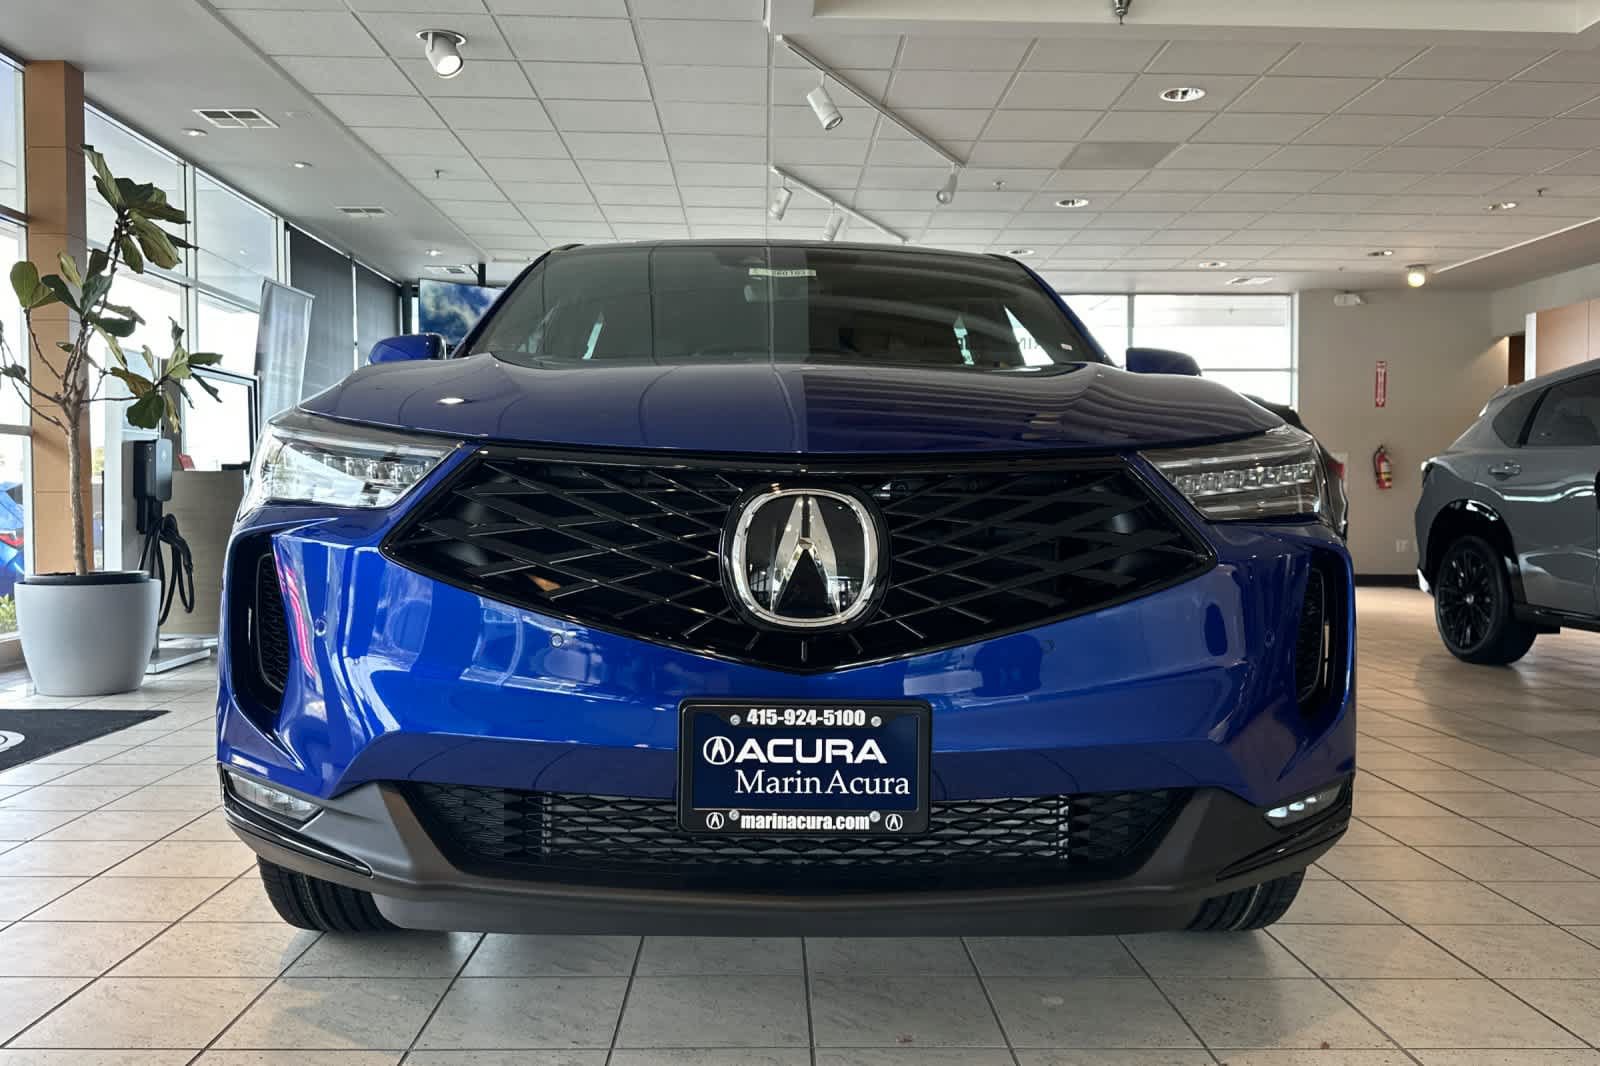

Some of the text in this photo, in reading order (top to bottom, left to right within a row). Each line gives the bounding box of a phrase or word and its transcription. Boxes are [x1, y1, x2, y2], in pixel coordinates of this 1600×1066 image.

[746, 709, 866, 726] 415-924-5100
[734, 738, 888, 764] ACURA
[735, 769, 911, 795] Marin Acura
[740, 812, 870, 831] marinacura.com
